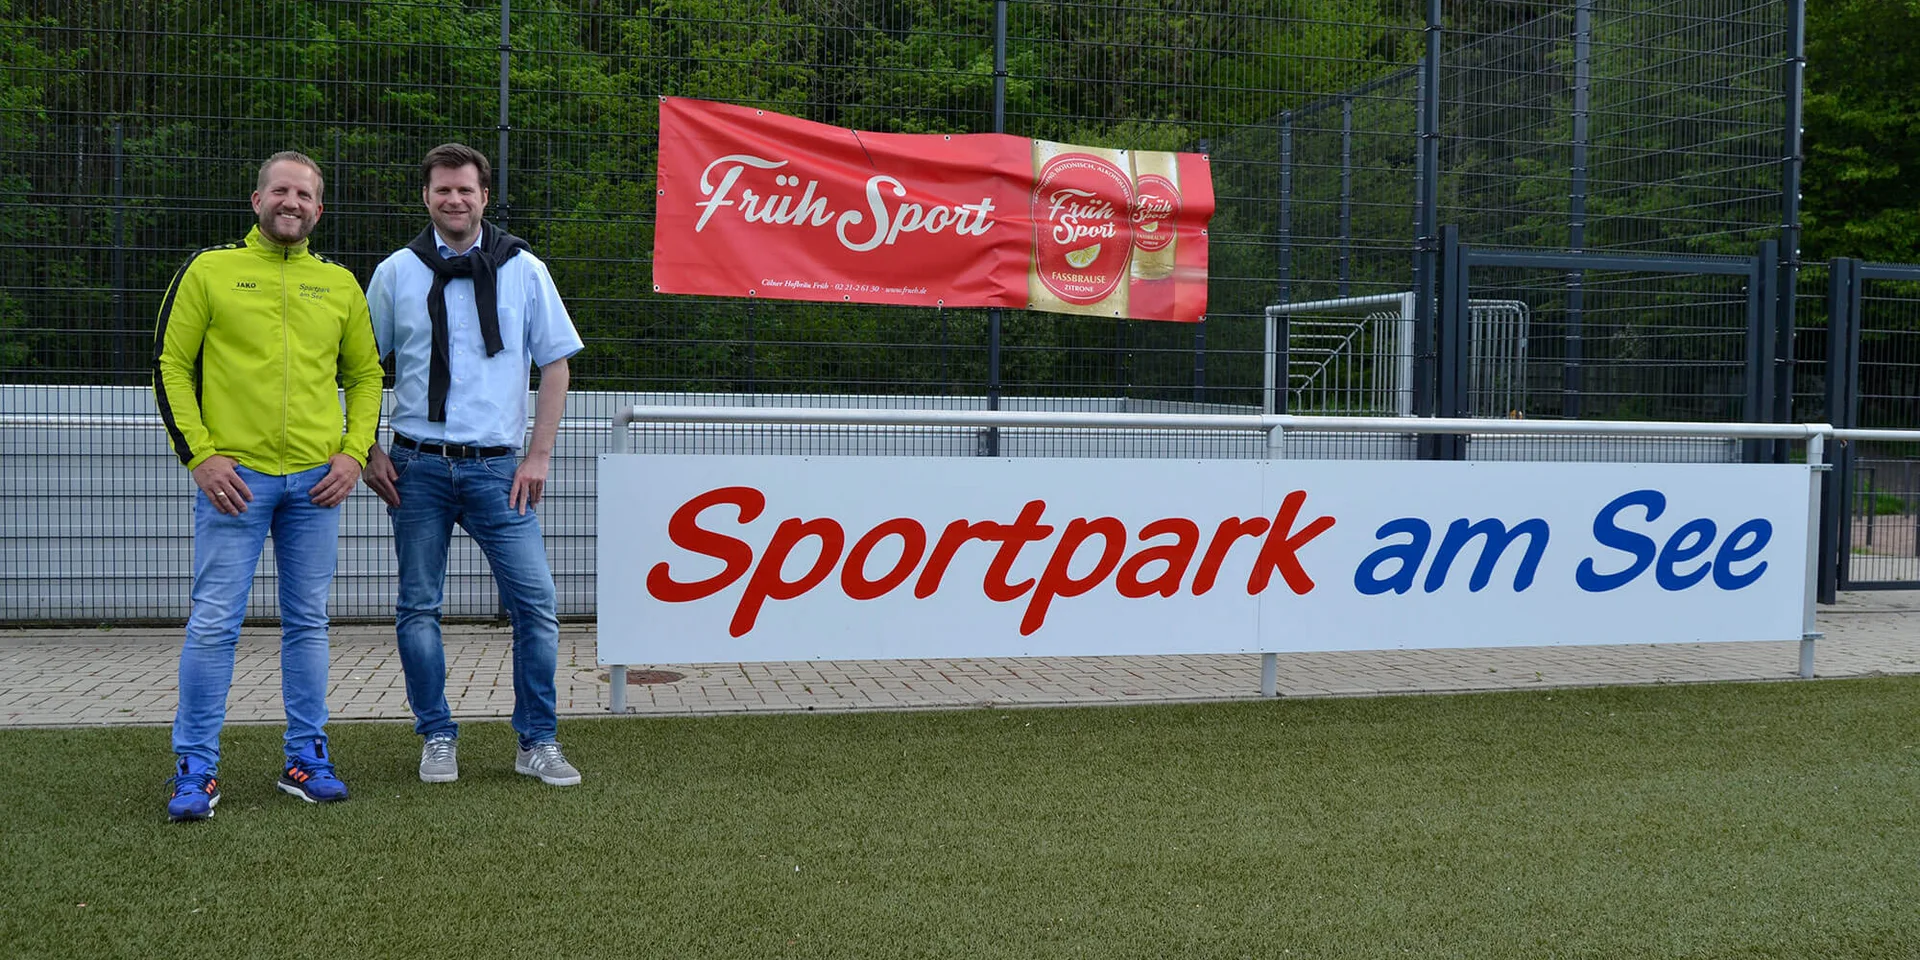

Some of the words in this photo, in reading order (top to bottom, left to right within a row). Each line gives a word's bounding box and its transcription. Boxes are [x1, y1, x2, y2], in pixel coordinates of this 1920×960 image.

[696, 154, 836, 233] Früh
[836, 175, 996, 252] Sport
[1048, 188, 1115, 222] Früh
[1136, 194, 1173, 213] Früh
[1053, 213, 1117, 245] Sport
[236, 281, 257, 289] JAKO
[784, 279, 811, 289] Hofbräu
[812, 280, 829, 290] Früh
[1051, 271, 1107, 284] FASSBRAUSE
[298, 283, 331, 293] Sportpark
[1064, 284, 1094, 293] ZITRONE
[647, 486, 1336, 639] Sportpark
[1353, 516, 1551, 597] am
[1574, 488, 1774, 594] See
